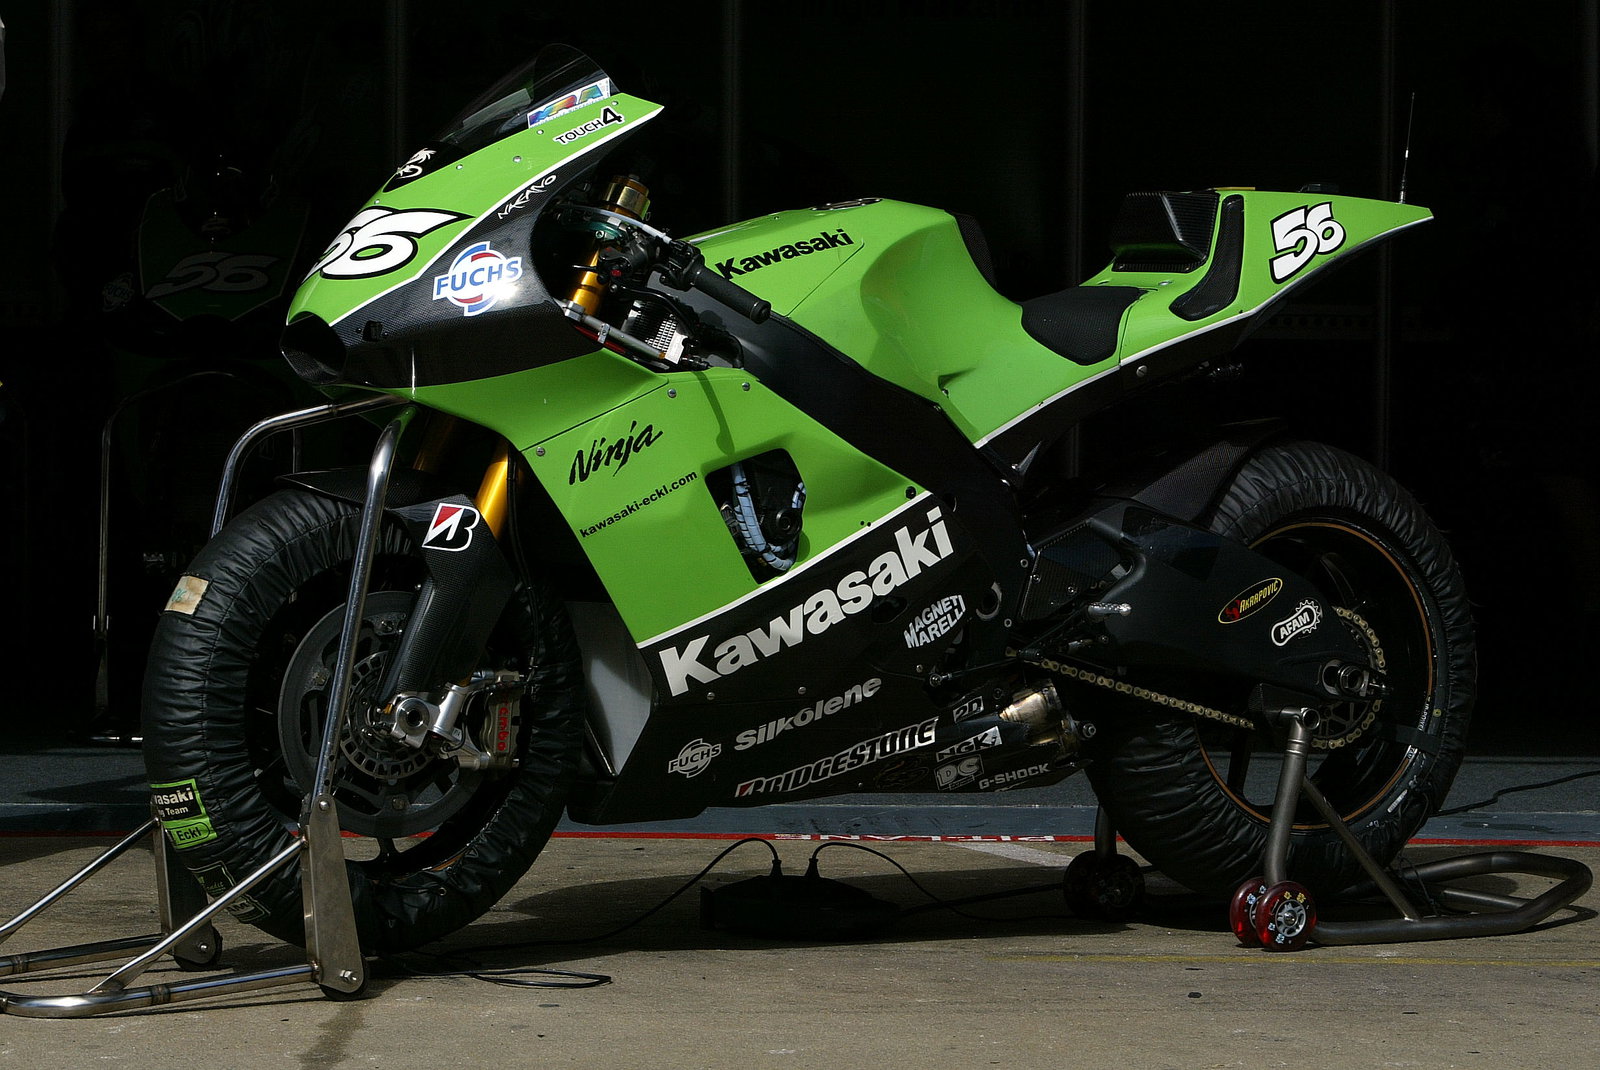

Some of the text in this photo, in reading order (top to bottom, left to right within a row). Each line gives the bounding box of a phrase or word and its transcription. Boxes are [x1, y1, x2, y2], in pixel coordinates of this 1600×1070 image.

[553, 106, 623, 145] TOUCH4
[300, 205, 476, 281] 56
[714, 228, 855, 281] Kawasaki
[1269, 202, 1346, 284] 56
[435, 258, 521, 297] FUCHS
[568, 420, 664, 486] Ninja
[579, 470, 698, 539] kawasaki-eckl.com
[658, 505, 955, 698] Kawasaki
[904, 595, 966, 642] MAGNETI
[904, 603, 966, 648] MARELLI
[1279, 611, 1311, 640] AFAM
[734, 677, 882, 751] Silkolene
[668, 744, 722, 774] FUCHS
[734, 716, 939, 798] BRIDGESTONE
[978, 762, 1050, 790] G-SHOCK
[153, 787, 194, 805] asaki
[164, 806, 189, 817] Team
